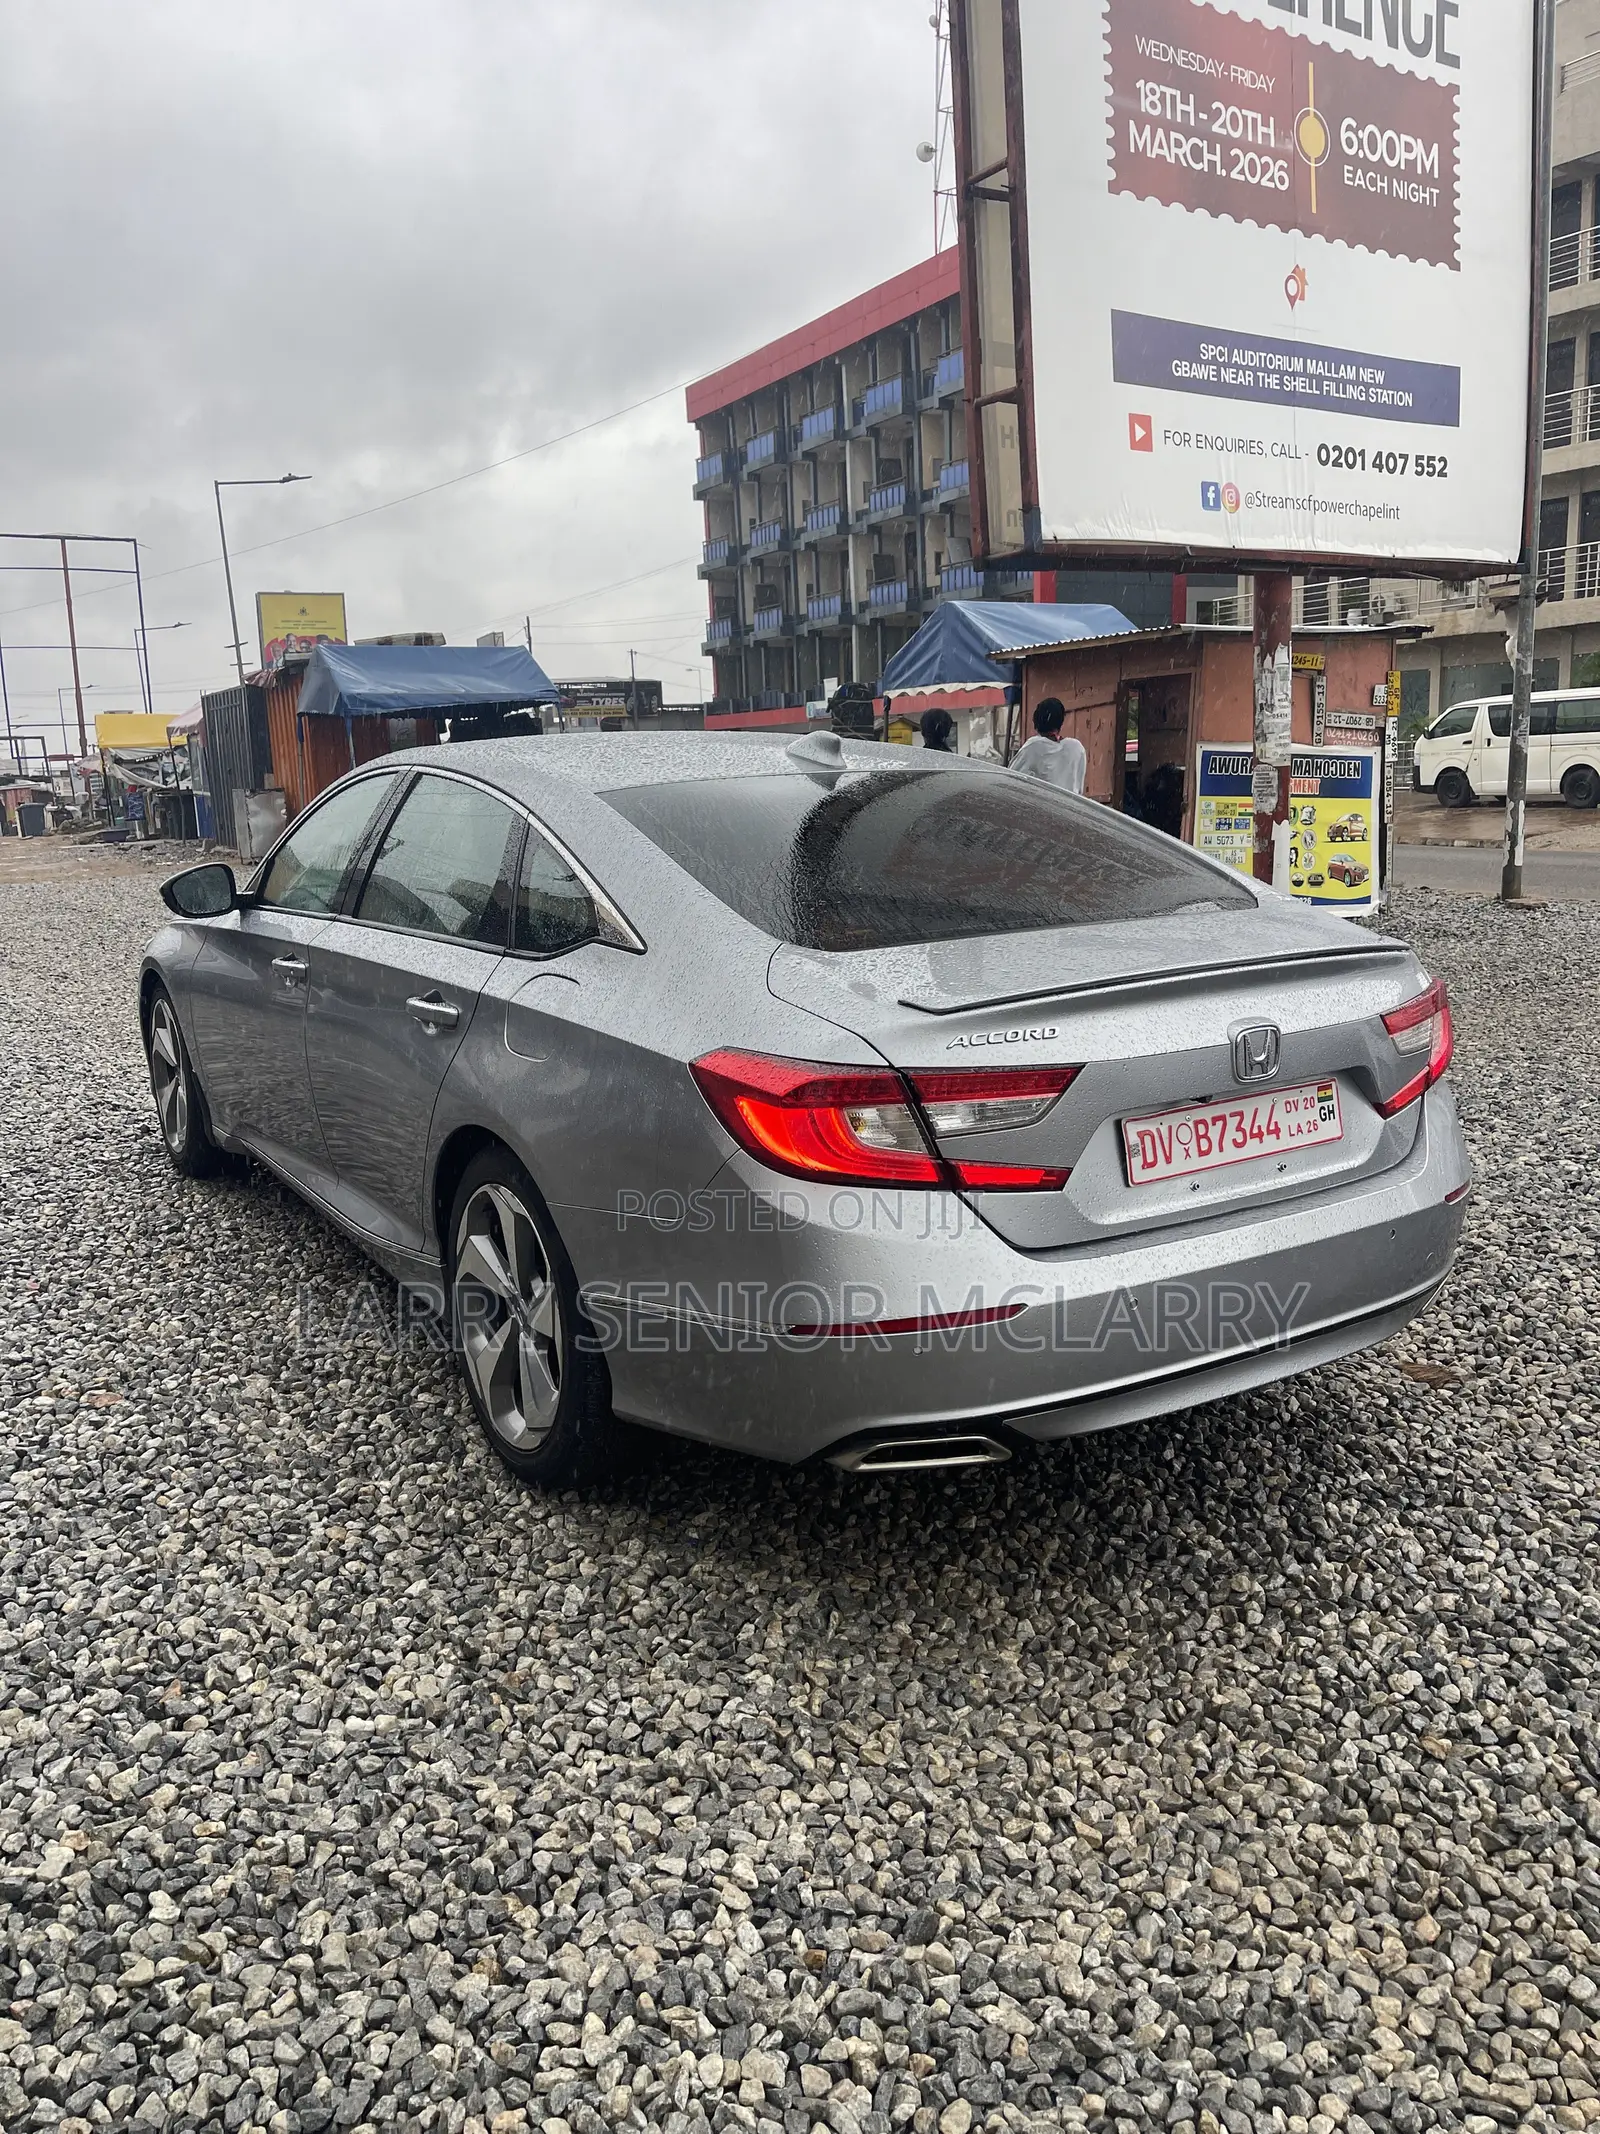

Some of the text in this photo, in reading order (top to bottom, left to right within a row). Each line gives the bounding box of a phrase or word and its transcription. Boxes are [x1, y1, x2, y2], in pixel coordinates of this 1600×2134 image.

[1230, 65, 1276, 94] FRIDAY
[1135, 79, 1195, 126] 18TH
[1211, 101, 1275, 147] 20TH
[1129, 119, 1290, 191] MARCH. 2026
[1340, 117, 1439, 179] 6:00PM
[1343, 164, 1440, 207] EACH NIGHT
[1171, 359, 1413, 407] GBAWE NEAR THE SHELL FILLING STATION
[1199, 343, 1386, 385] SPCI AUDITORIUM MALLAM NEW
[1163, 430, 1192, 448] FOR
[1195, 434, 1268, 459] ENQUIRIES,
[1270, 443, 1302, 460] CALL
[1316, 443, 1367, 471] 0201
[1371, 450, 1410, 475] 407
[1413, 454, 1449, 478] 552
[591, 697, 626, 706] TYRES
[946, 1025, 1061, 1050] ACCORD
[1284, 1096, 1316, 1114] DV 20
[1318, 1104, 1336, 1123] GH
[1136, 1103, 1282, 1170] DV B7344
[1288, 1119, 1319, 1137] LA 26
